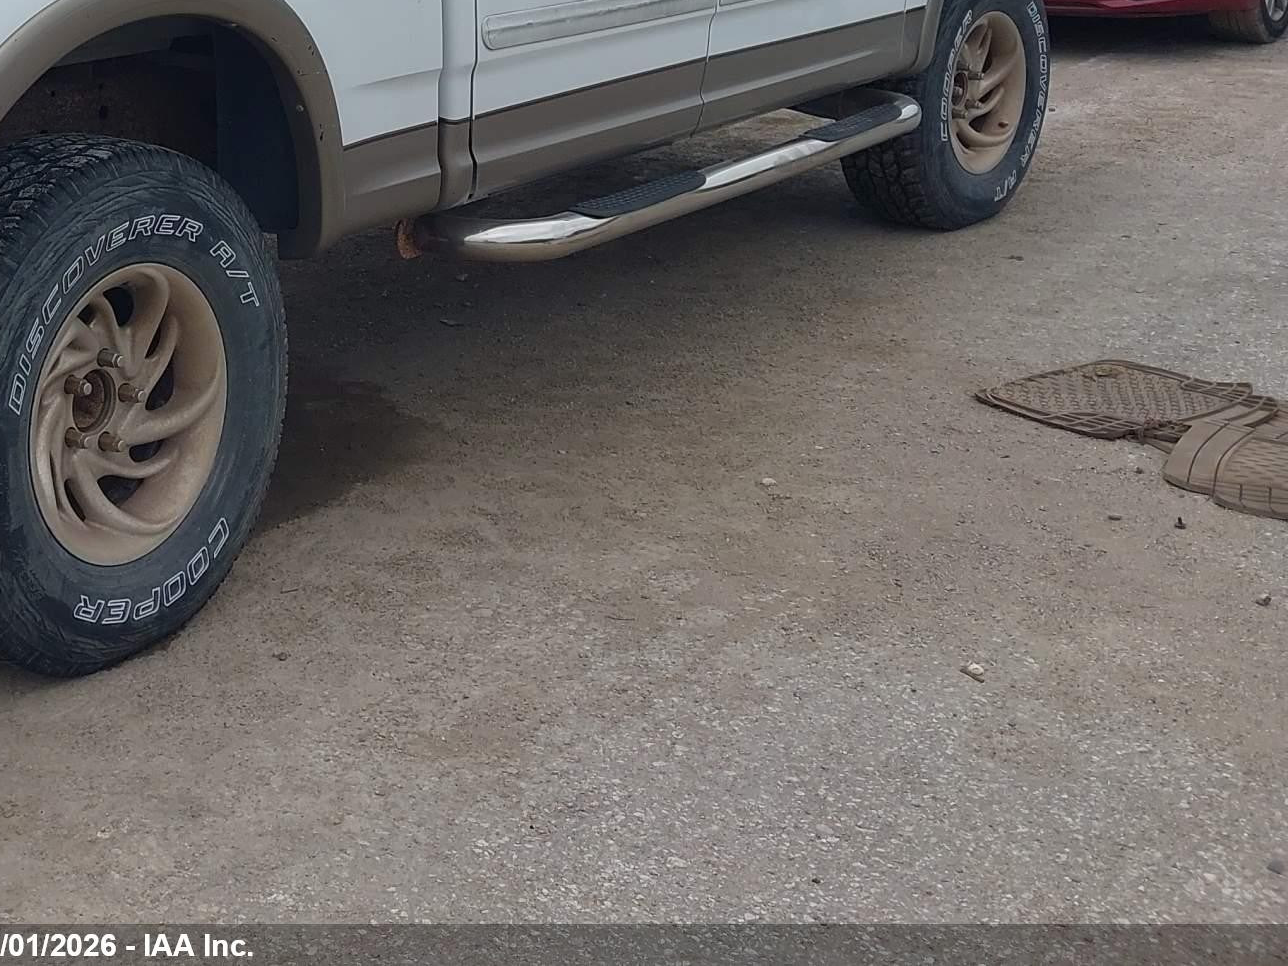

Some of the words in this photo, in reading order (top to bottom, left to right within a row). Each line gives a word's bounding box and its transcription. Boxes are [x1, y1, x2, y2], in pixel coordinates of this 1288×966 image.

[940, 9, 973, 142] COOPER
[1020, 1, 1048, 168] DISCOVERER
[8, 213, 204, 416] DISCOVERER
[209, 239, 261, 308] A/T
[73, 517, 230, 625] COOPER
